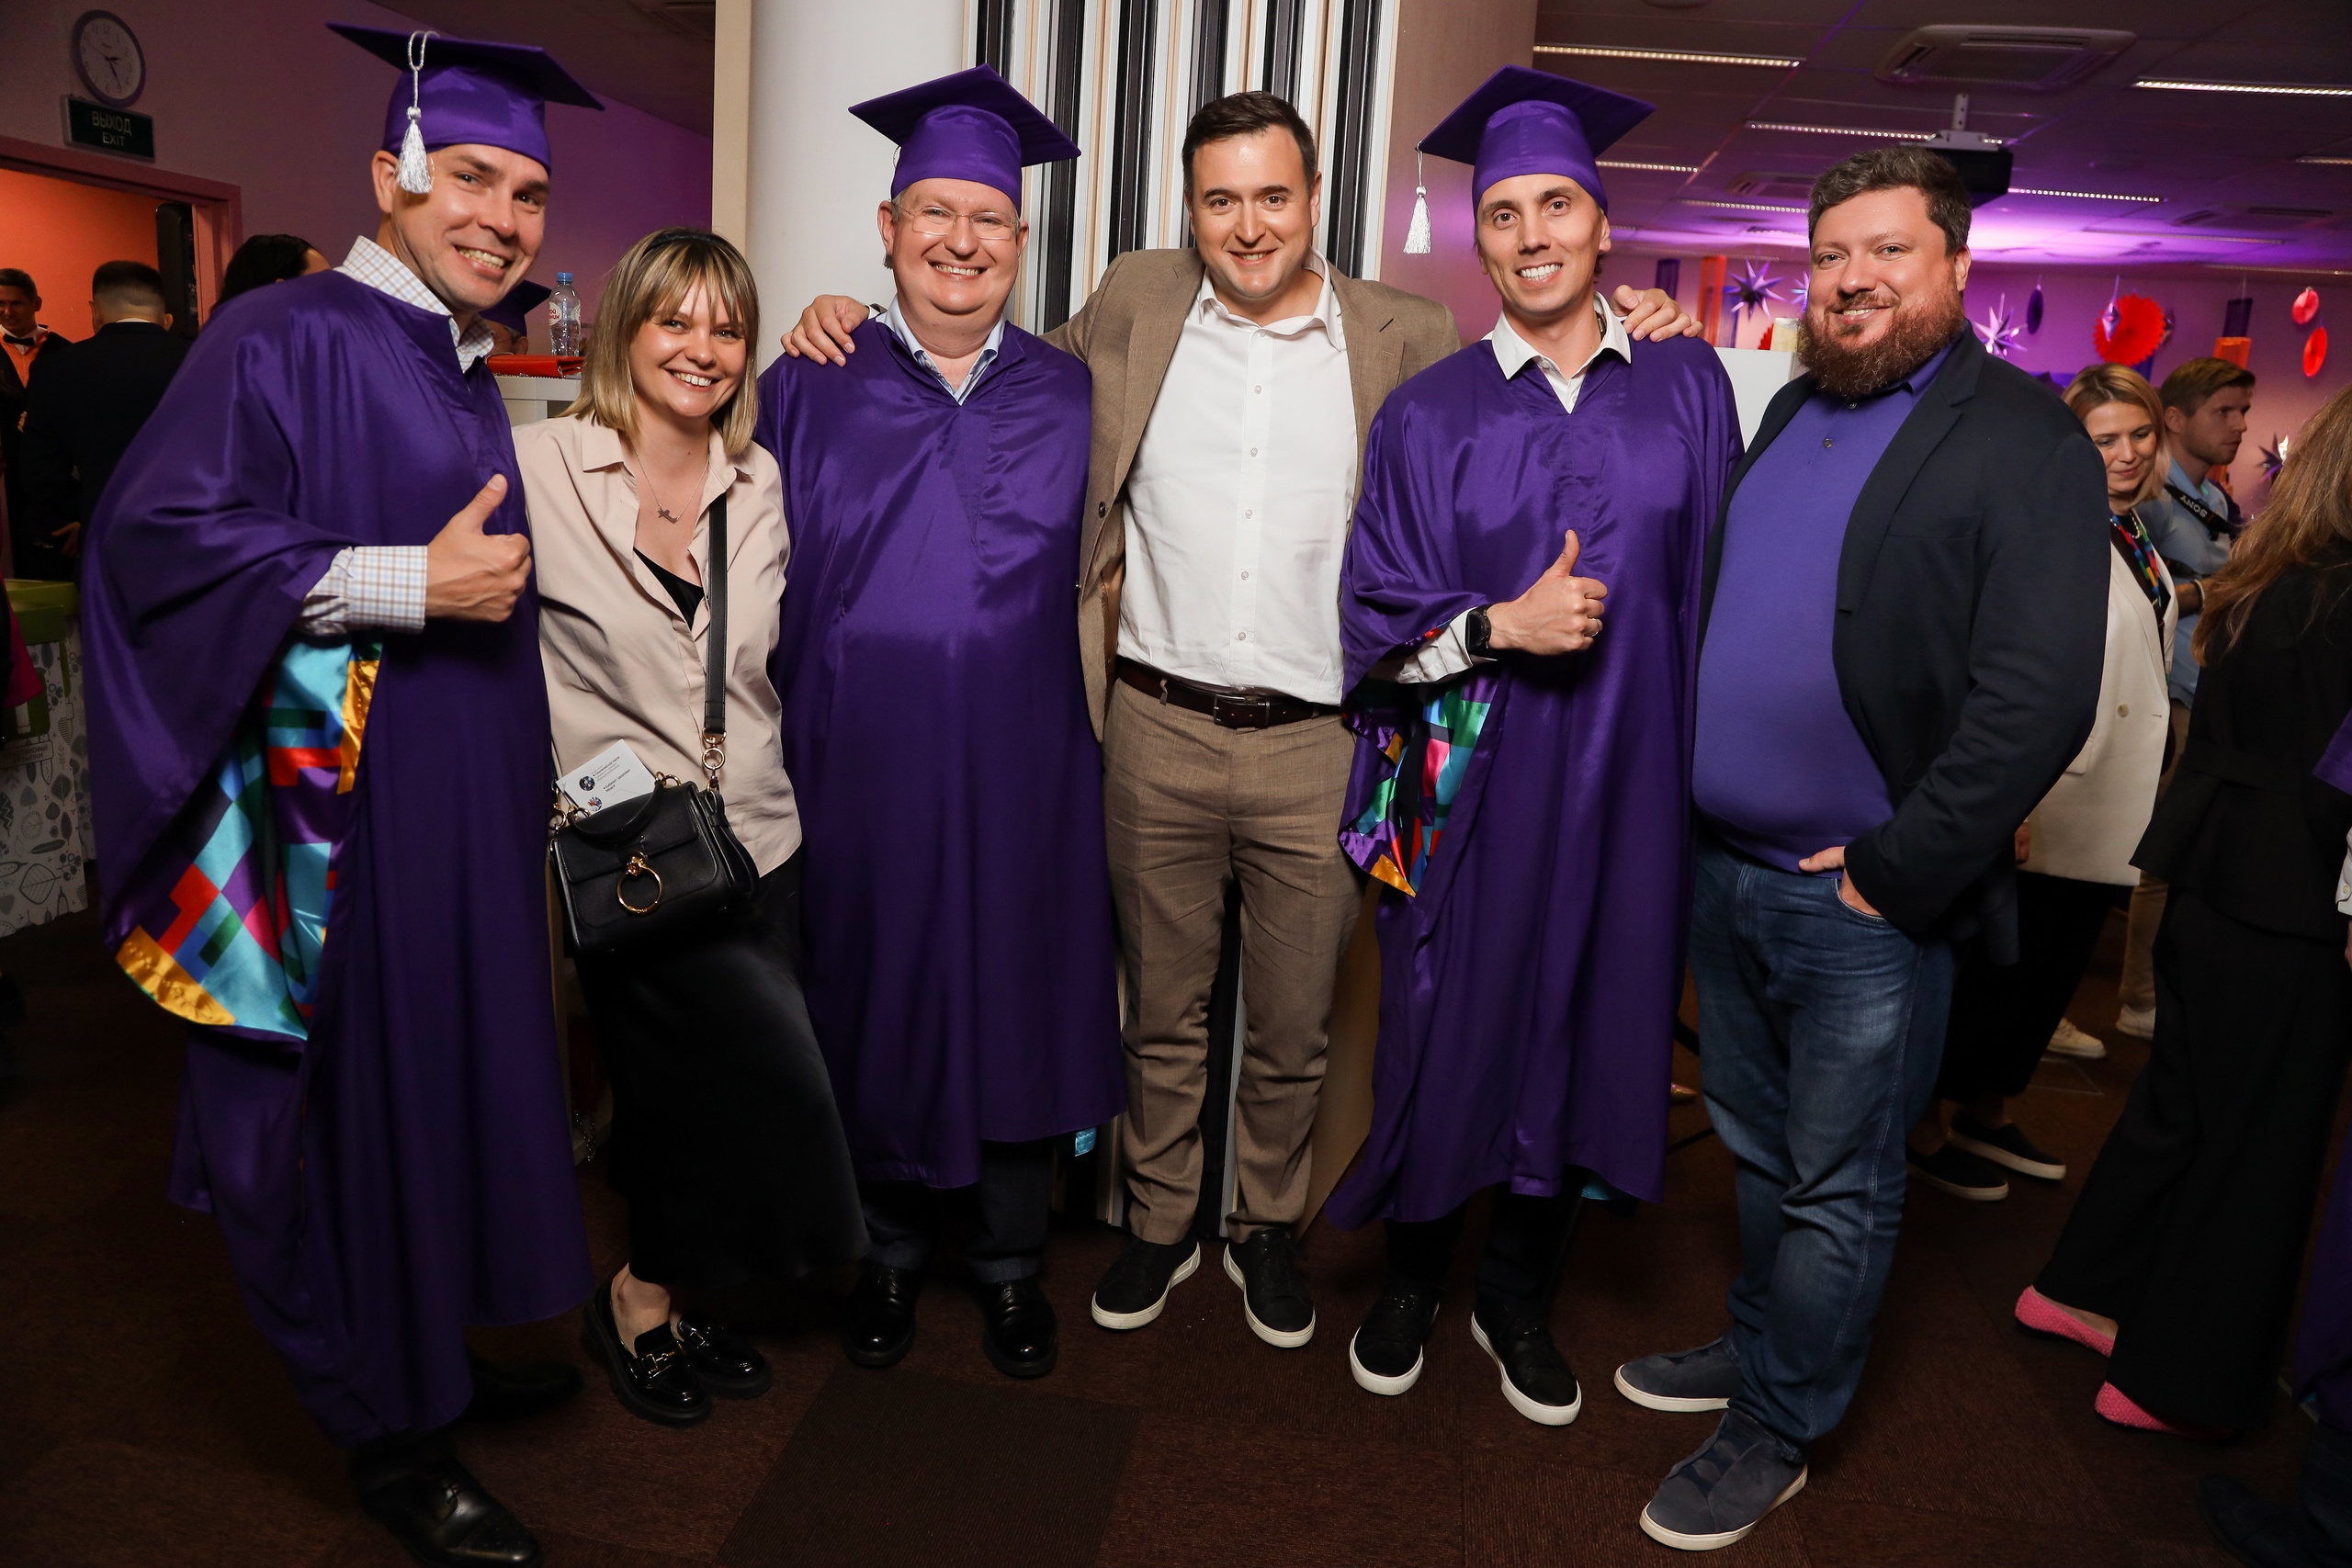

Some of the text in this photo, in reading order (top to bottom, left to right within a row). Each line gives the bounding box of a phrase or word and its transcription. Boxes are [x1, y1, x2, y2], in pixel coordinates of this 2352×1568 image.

[92, 110, 132, 136] ВЫХОД
[102, 131, 126, 147] EXIT
[2180, 494, 2208, 518] SONY
